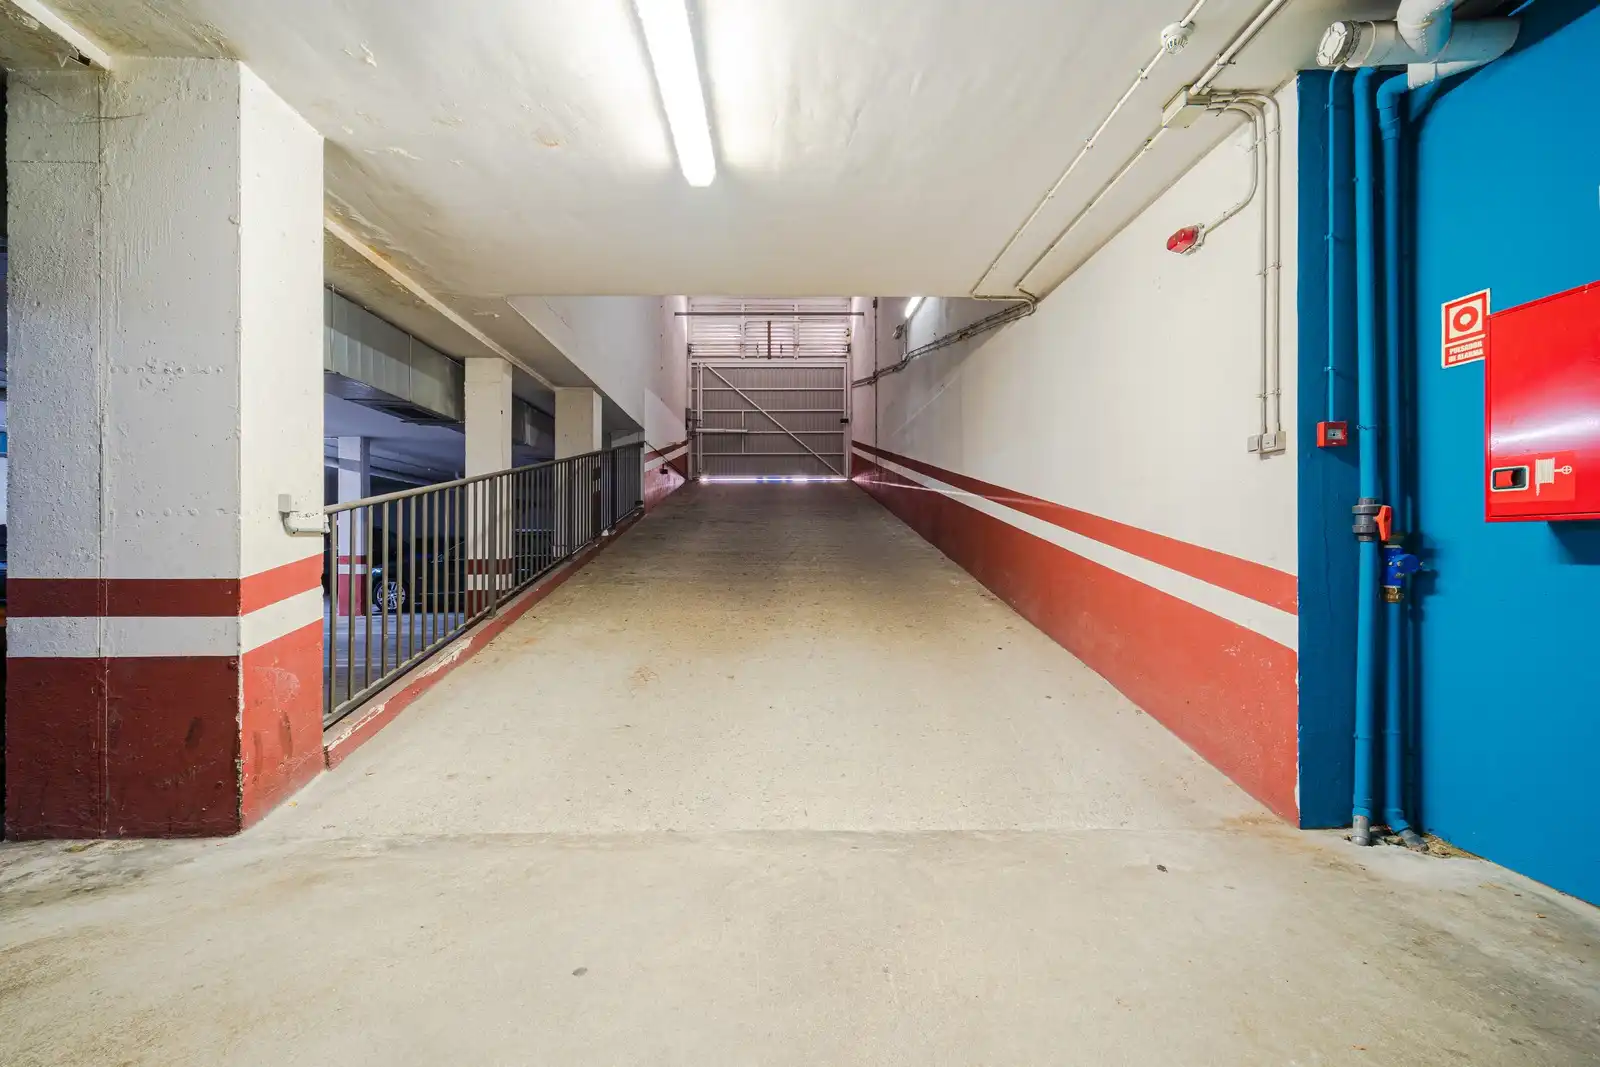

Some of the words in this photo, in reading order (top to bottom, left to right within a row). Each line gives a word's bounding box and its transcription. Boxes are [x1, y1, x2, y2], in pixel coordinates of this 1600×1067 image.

[1449, 340, 1483, 355] PULSADOR
[1448, 354, 1458, 363] DE
[1458, 348, 1484, 361] ALARMA
